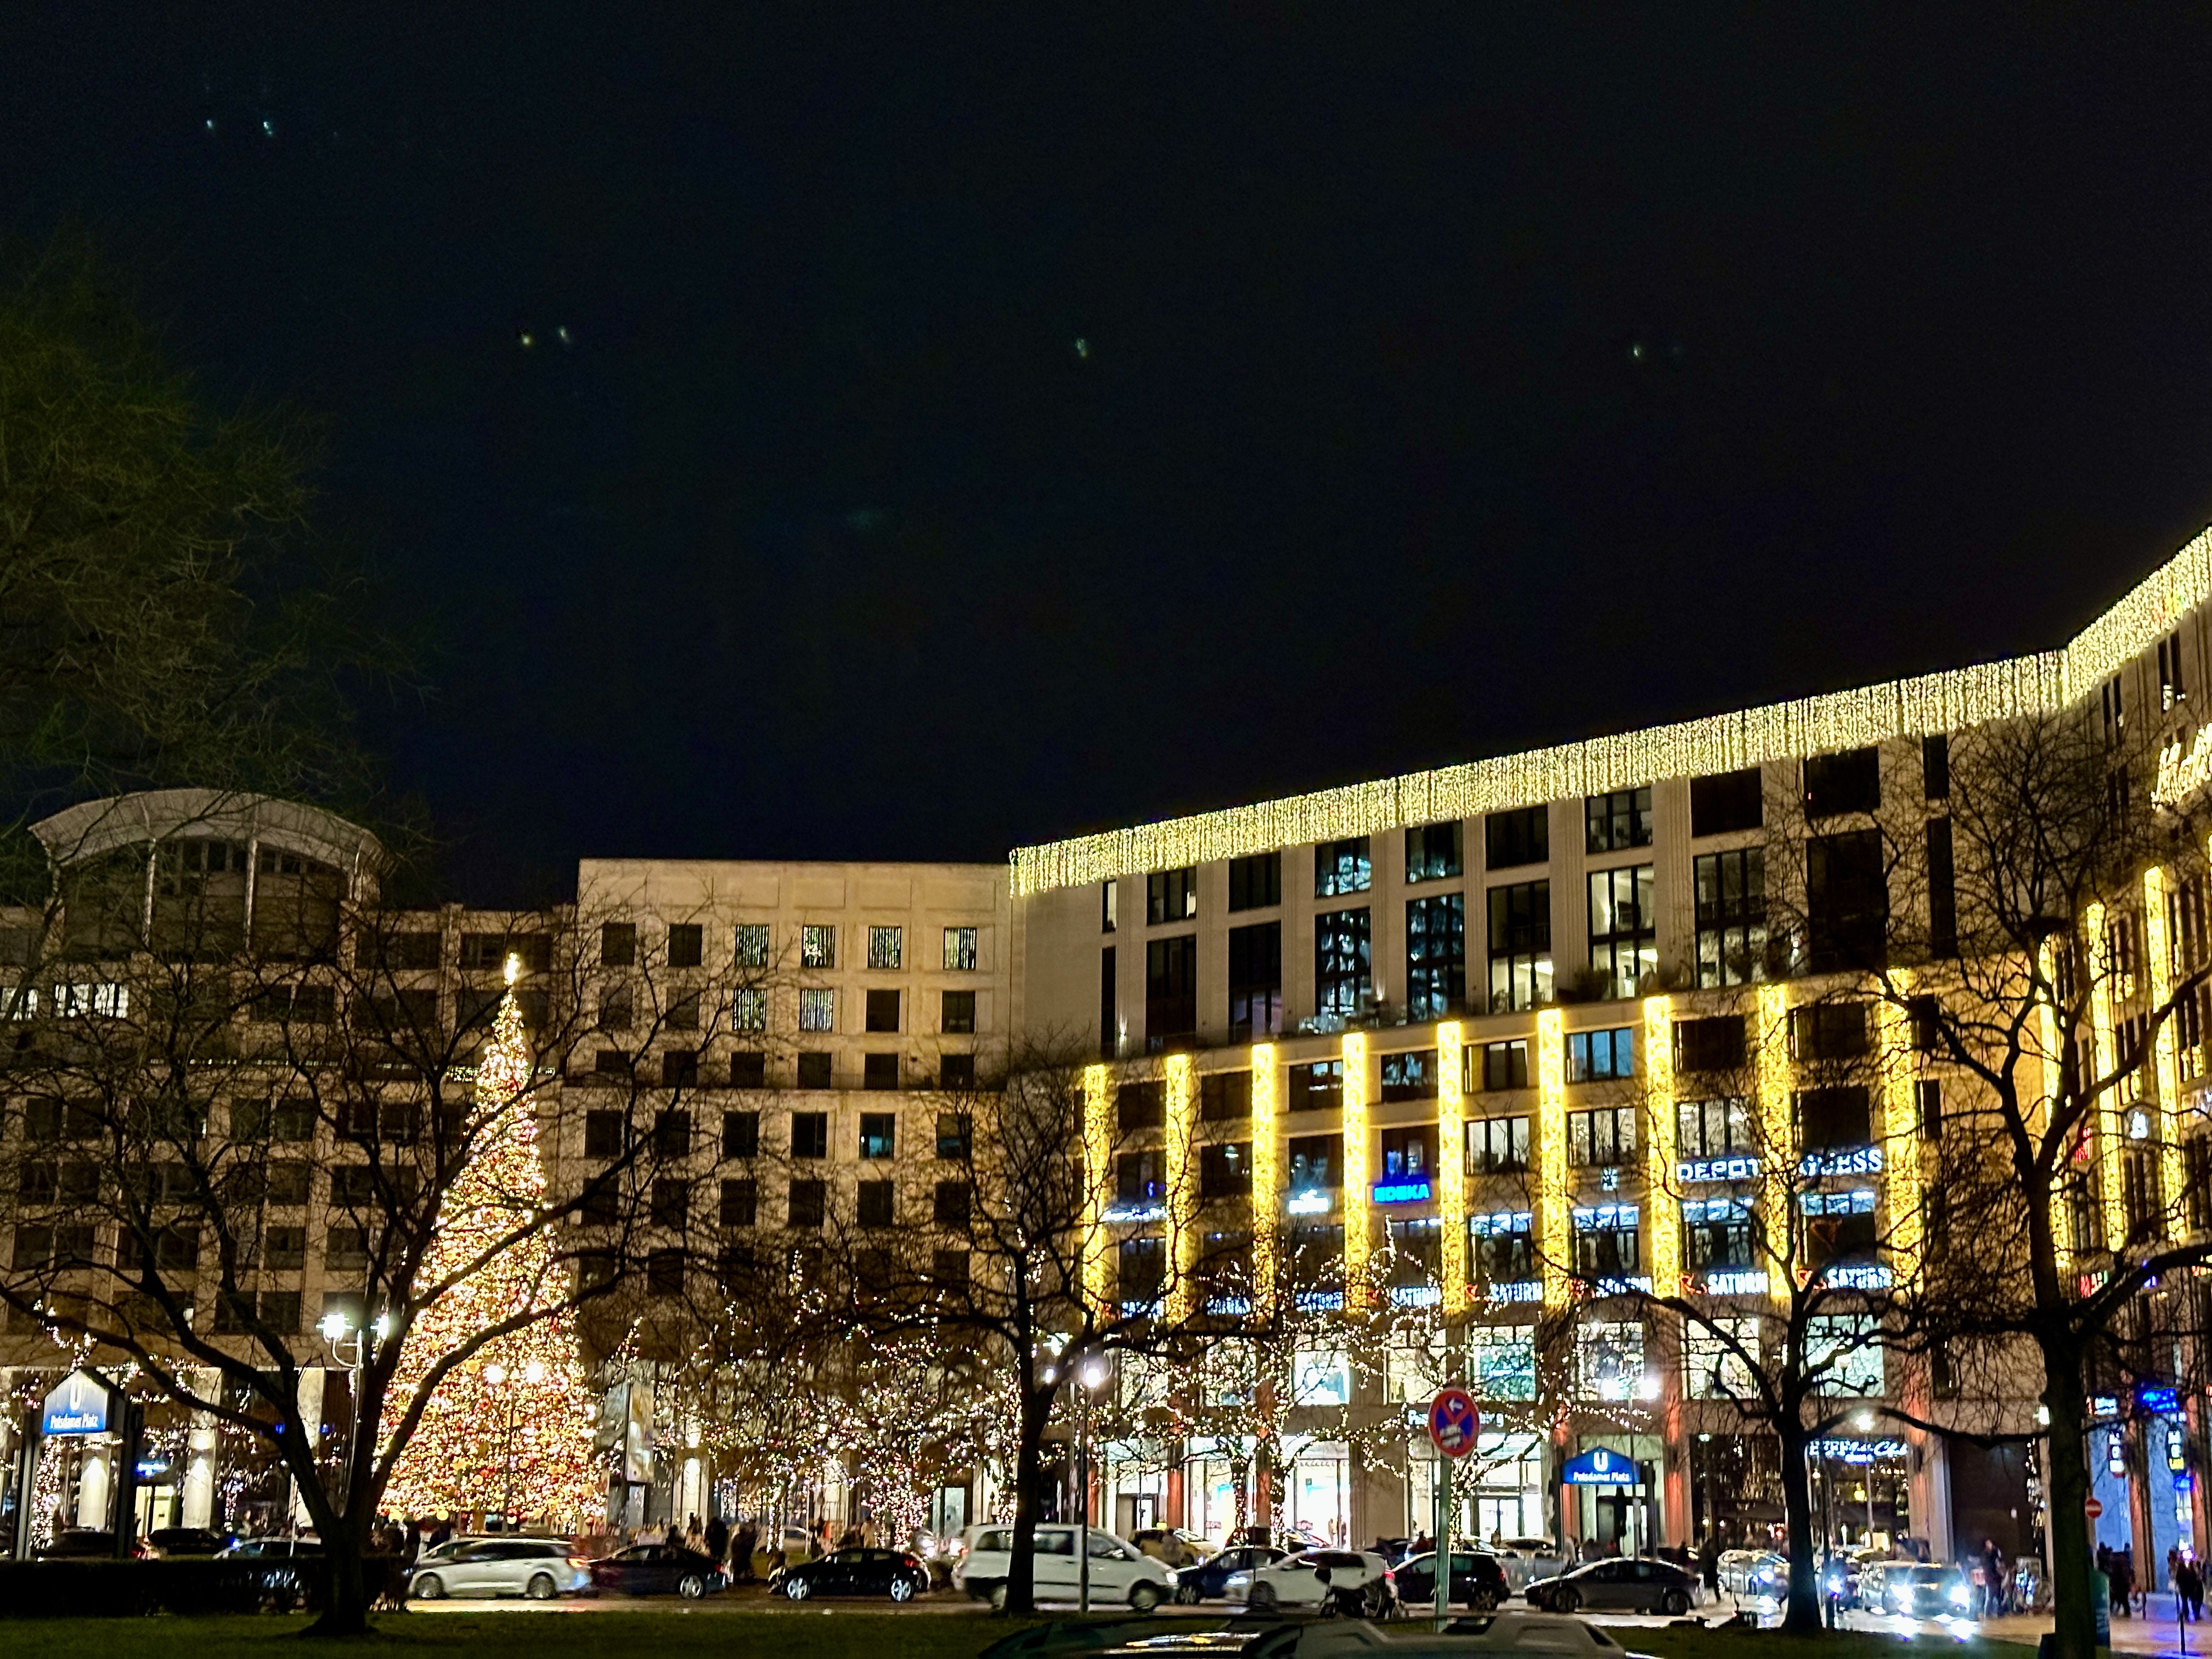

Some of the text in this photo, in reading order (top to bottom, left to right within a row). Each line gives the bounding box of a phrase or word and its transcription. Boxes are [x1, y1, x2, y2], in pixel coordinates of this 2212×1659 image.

[1676, 1158, 1760, 1180] DEPOT
[1374, 1183, 1429, 1203] EDEKA
[1489, 1282, 1543, 1302] SATURN
[1708, 1272, 1768, 1295] SATURN
[70, 1378, 82, 1410] U
[50, 1413, 98, 1429] Potsdamer Platz
[1593, 1452, 1609, 1472] U
[1573, 1471, 1630, 1482] Potsdamer Platz
